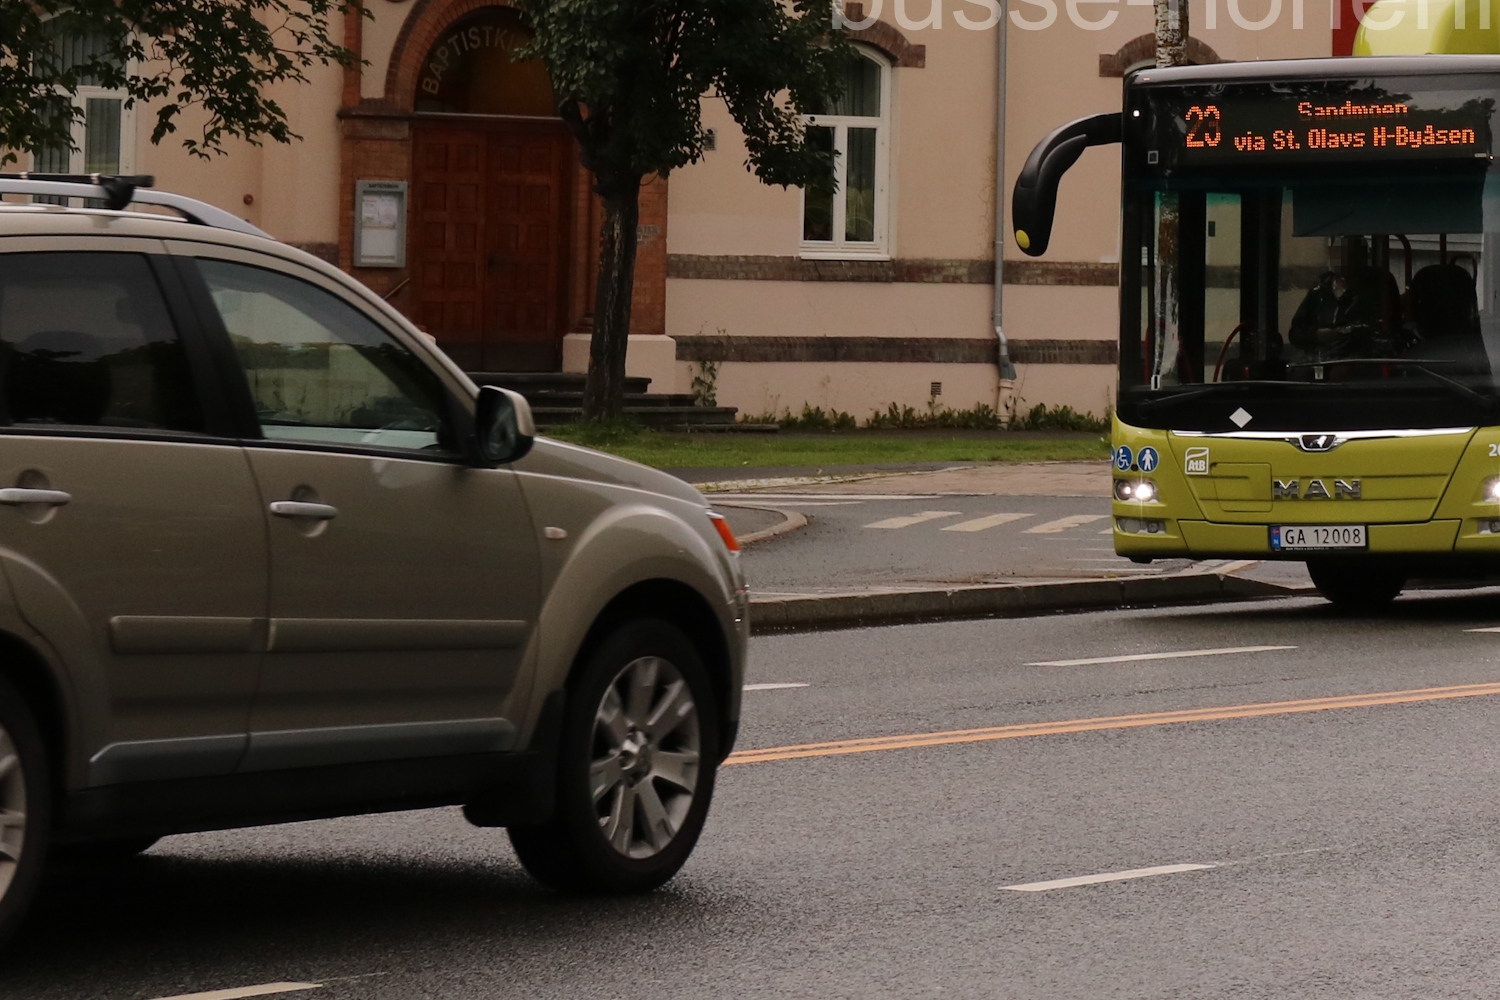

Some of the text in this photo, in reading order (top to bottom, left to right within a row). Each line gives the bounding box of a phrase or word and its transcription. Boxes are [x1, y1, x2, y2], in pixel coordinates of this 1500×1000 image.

[1185, 105, 1220, 147] 23
[1234, 125, 1475, 151] via St. Olavs H-Byåsen
[1188, 459, 1206, 472] AtB
[1273, 479, 1362, 500] MAN
[1285, 528, 1361, 545] GA 12008
